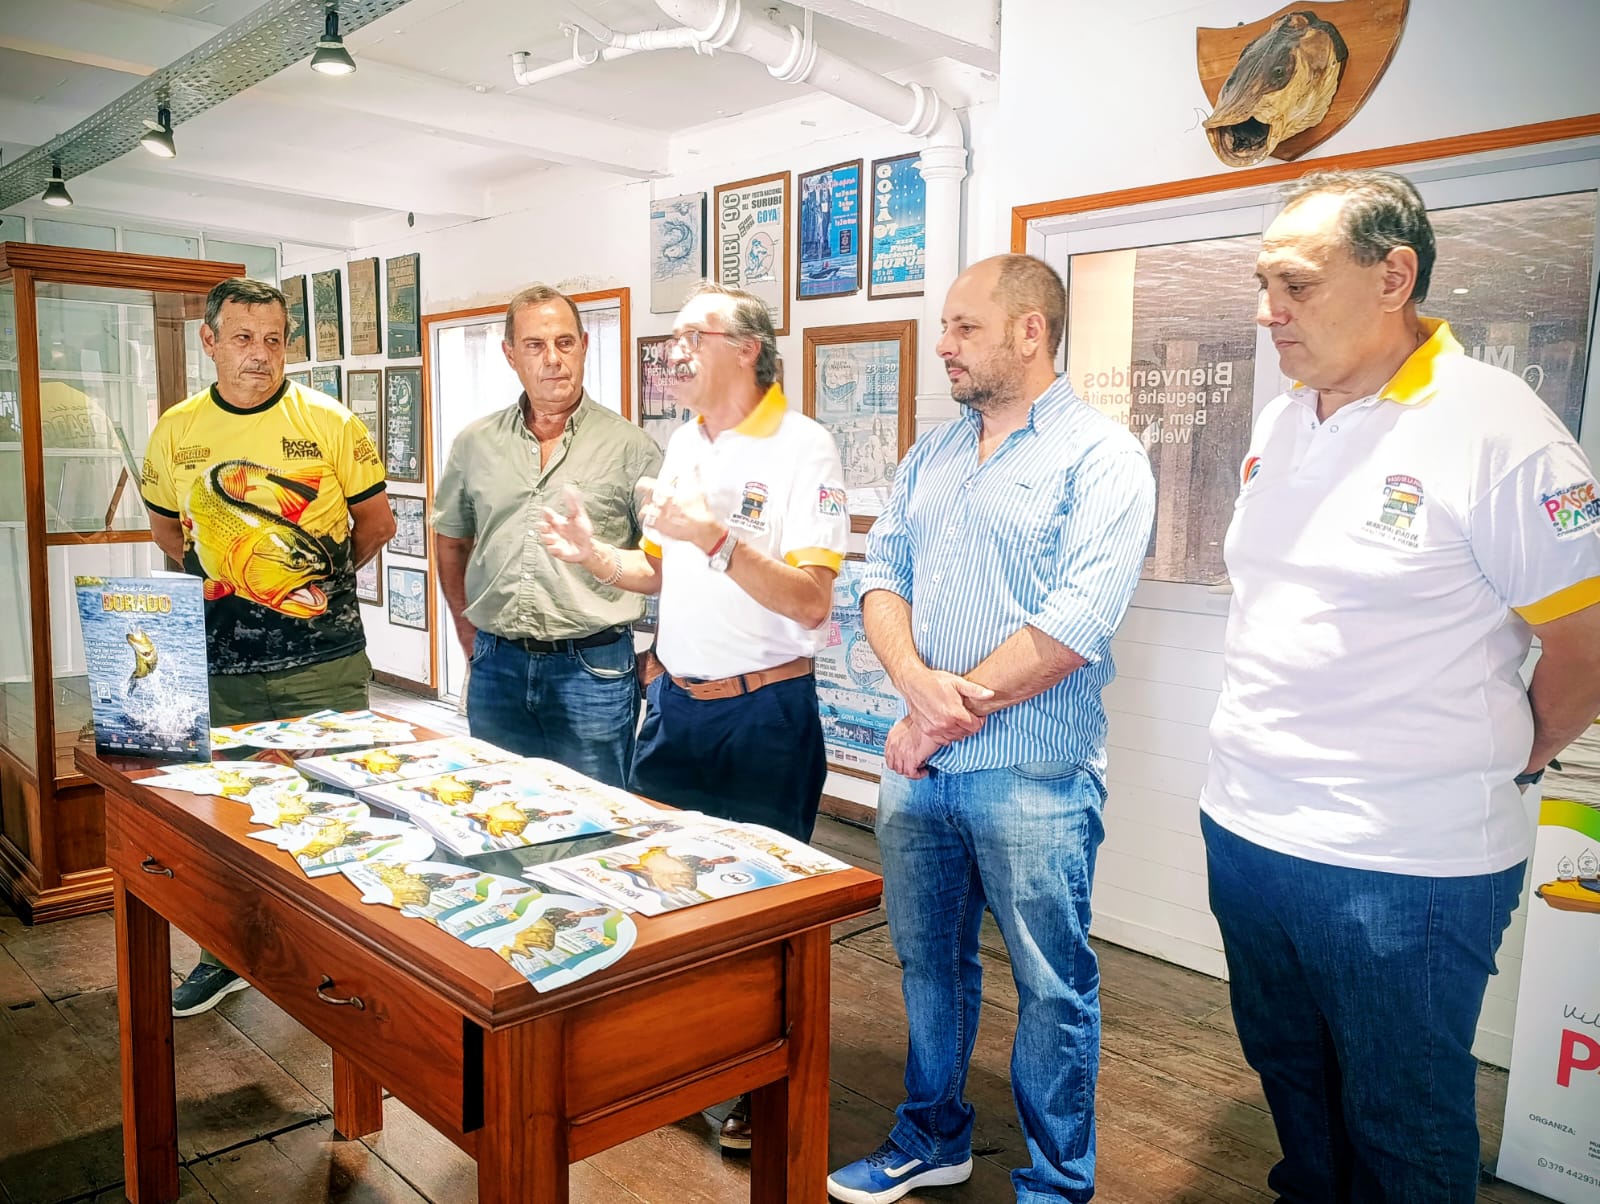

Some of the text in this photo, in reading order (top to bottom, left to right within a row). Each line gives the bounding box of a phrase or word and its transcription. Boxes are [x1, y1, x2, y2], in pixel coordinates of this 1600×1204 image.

[751, 195, 782, 209] SURUBI
[757, 208, 777, 224] GOYA
[884, 362, 896, 375] 30
[102, 593, 172, 614] DORADO
[1528, 1113, 1577, 1136] ORGANIZA:
[1547, 1161, 1565, 1174] 379
